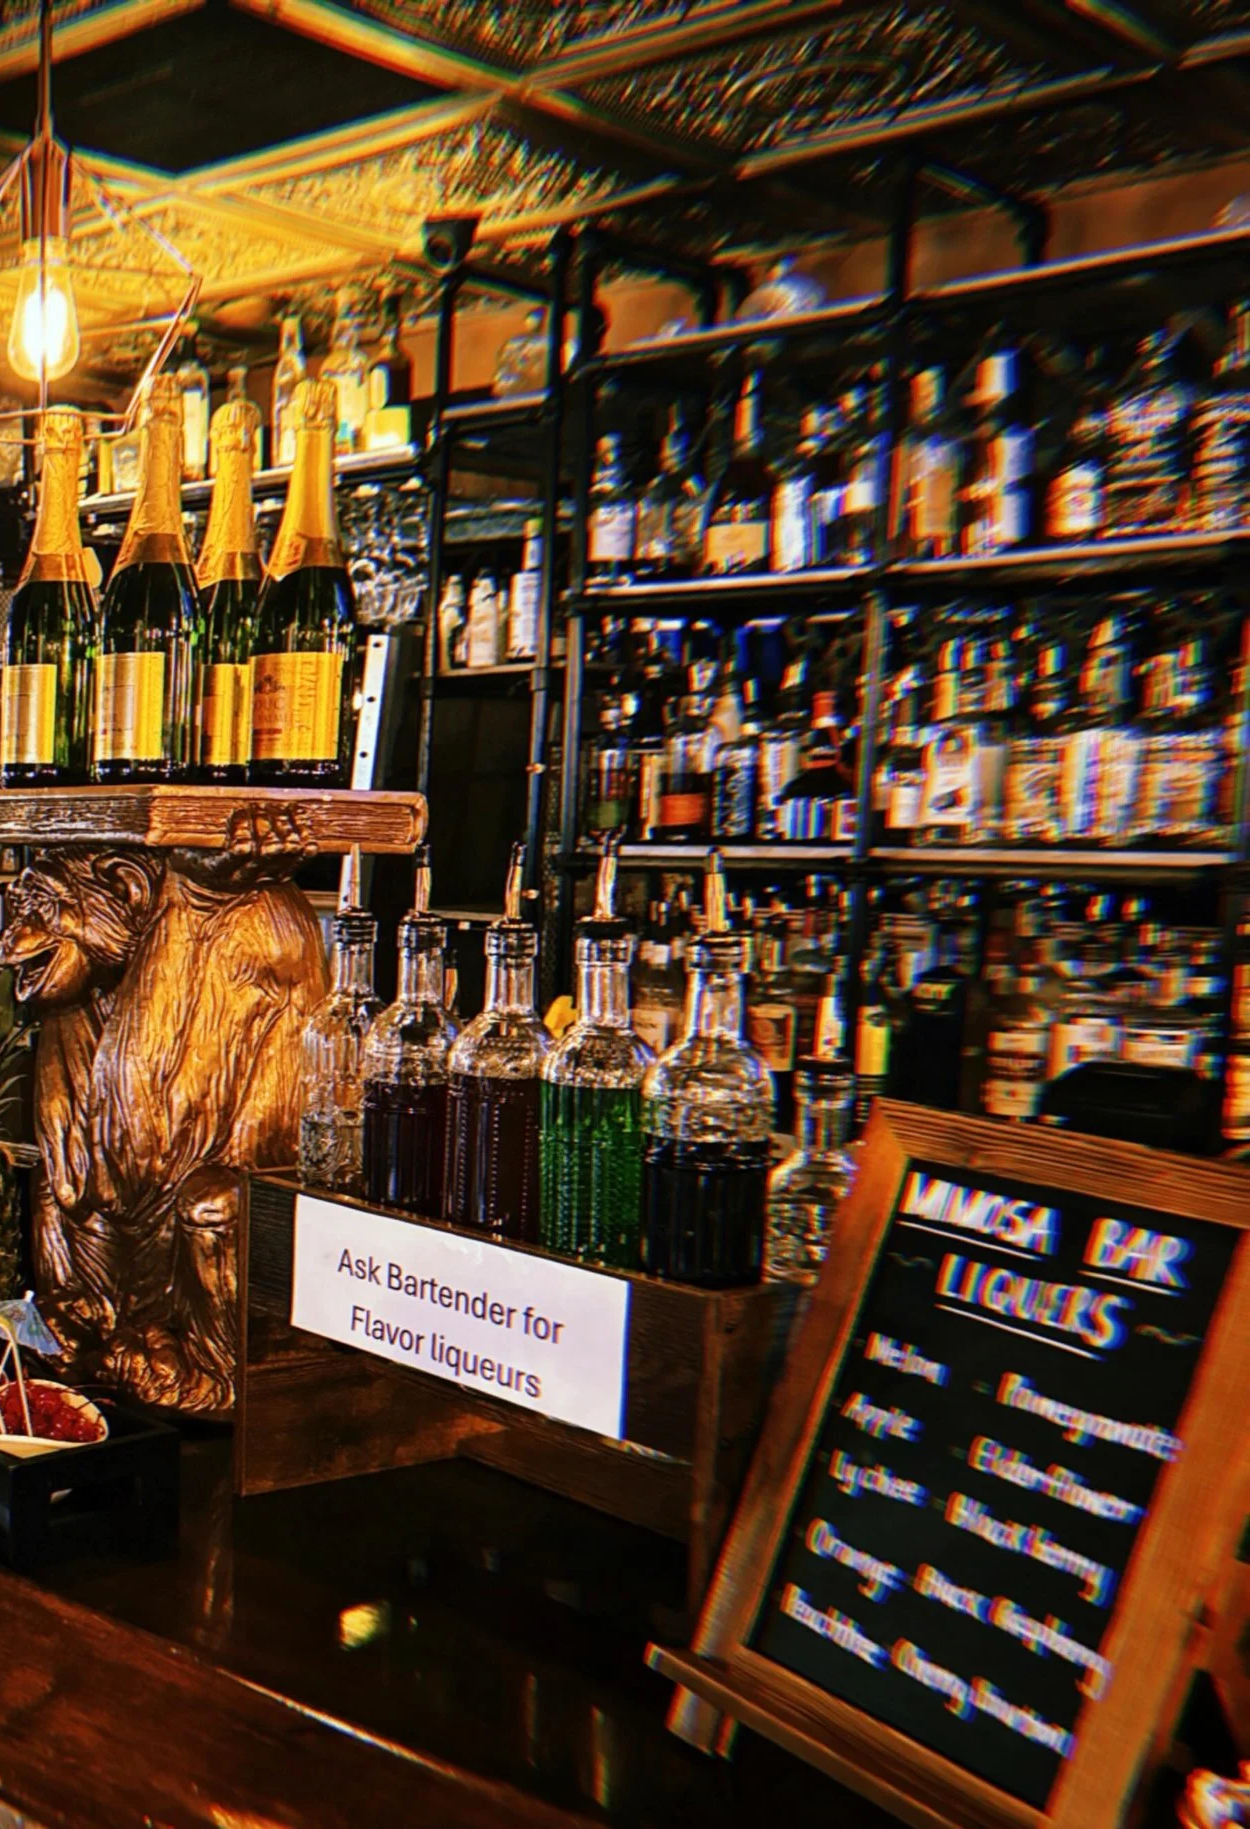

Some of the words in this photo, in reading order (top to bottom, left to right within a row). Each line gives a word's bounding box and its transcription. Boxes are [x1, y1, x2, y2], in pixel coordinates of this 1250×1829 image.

[899, 1172, 1062, 1256] MIMOSA
[1083, 1217, 1194, 1289] BAR
[338, 1248, 381, 1286] Ask
[387, 1263, 516, 1329] Bartender
[523, 1307, 564, 1344] for
[350, 1304, 425, 1355] Flavor
[431, 1333, 542, 1399] liqueurs
